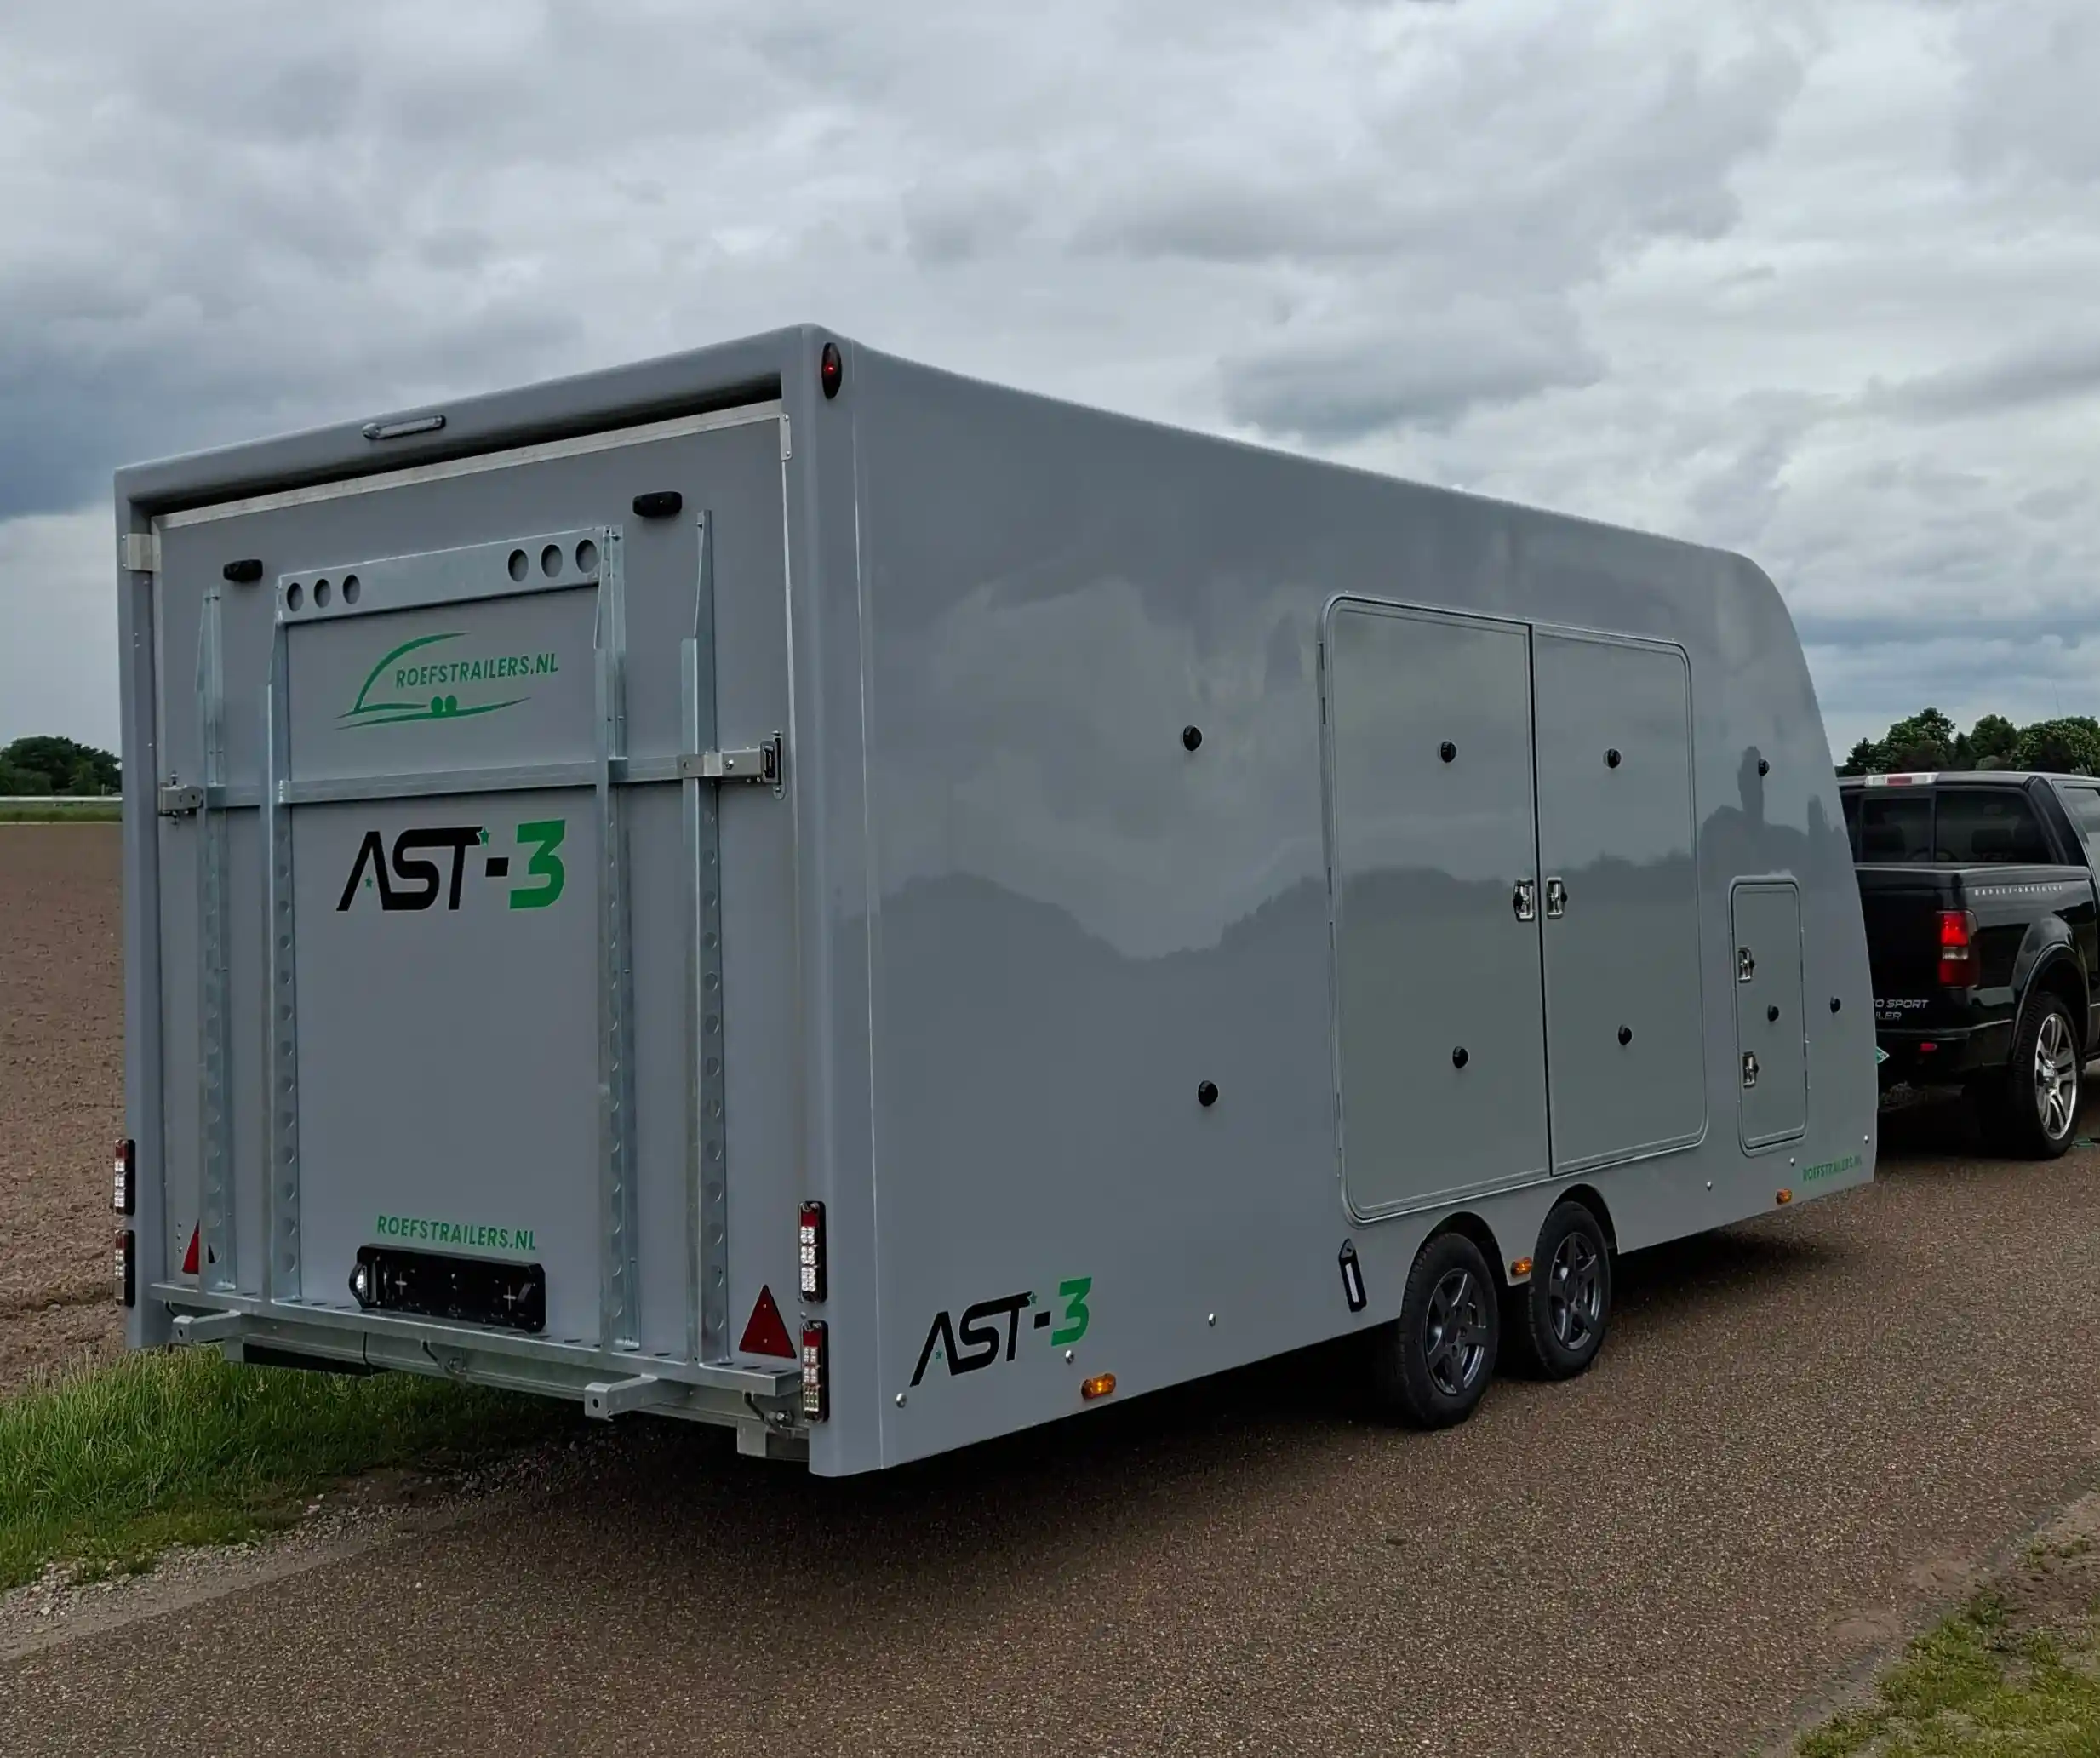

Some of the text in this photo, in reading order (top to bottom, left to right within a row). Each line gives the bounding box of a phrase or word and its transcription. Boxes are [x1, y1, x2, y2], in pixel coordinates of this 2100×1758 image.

[395, 653, 559, 689] ROEFSTRAILERS.NL
[336, 820, 566, 912] AST-3
[1886, 999, 1930, 1009] SPORT
[377, 1215, 536, 1251] ROEFSTRAILERS.NL
[909, 1277, 1092, 1387] AST-3
